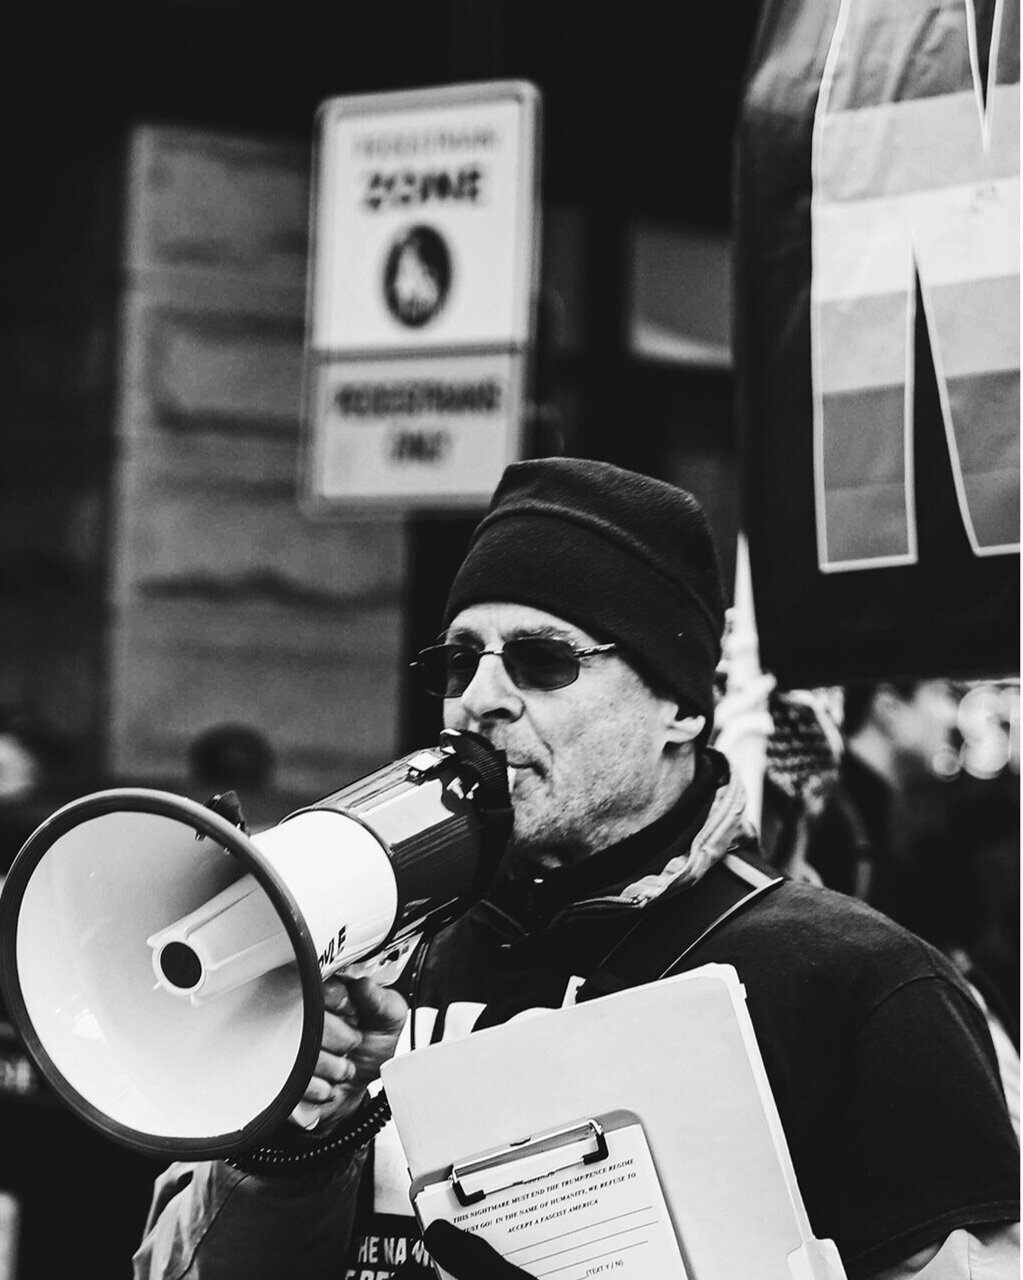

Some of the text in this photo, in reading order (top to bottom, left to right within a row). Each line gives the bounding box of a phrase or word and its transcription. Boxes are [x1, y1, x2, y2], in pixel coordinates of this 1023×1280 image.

[453, 1214, 469, 1224] THIS
[470, 1200, 509, 1218] NIGHTMARE
[512, 1193, 530, 1204] MUST
[531, 1189, 545, 1197] END
[547, 1184, 558, 1192] THE
[609, 1159, 633, 1172] REGIME
[505, 1212, 517, 1221] THE
[520, 1205, 537, 1216] NAME
[600, 1176, 625, 1188] REFUSE
[508, 1220, 532, 1233] ACCEPT
[541, 1209, 566, 1223] FASCIST
[568, 1199, 598, 1213] AMERICA
[357, 1236, 379, 1263] HE
